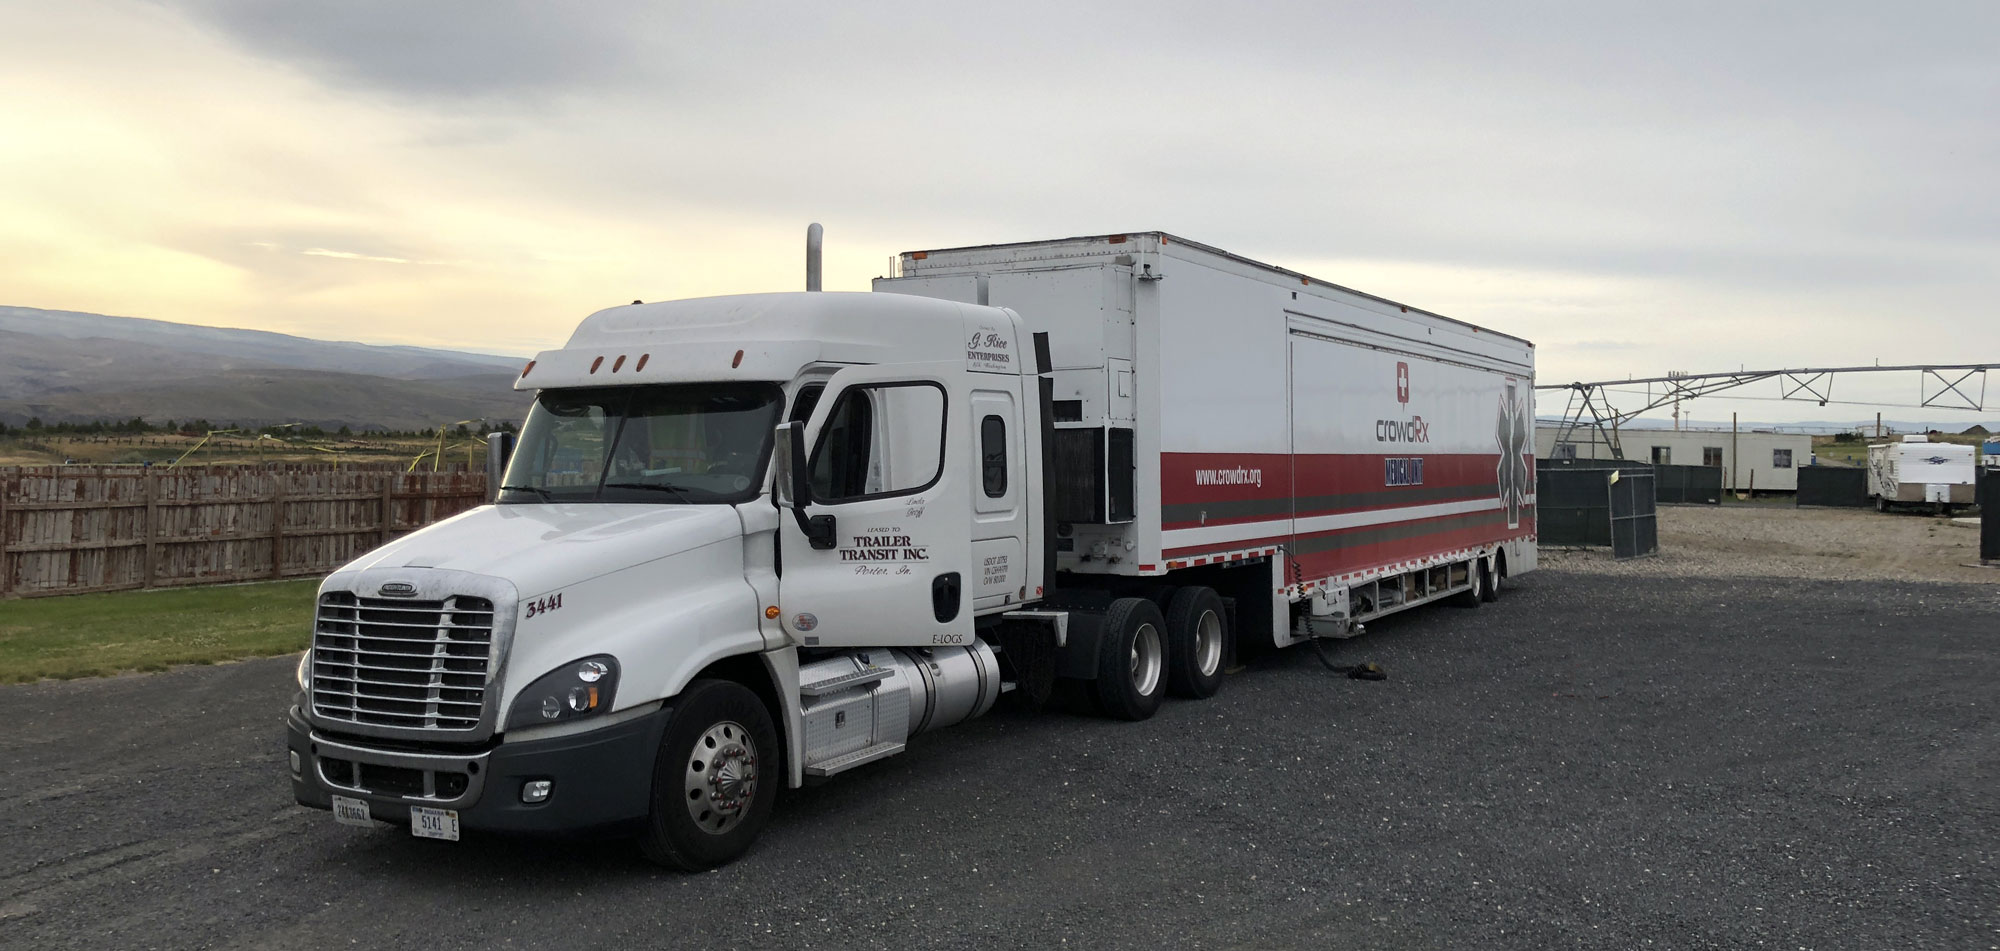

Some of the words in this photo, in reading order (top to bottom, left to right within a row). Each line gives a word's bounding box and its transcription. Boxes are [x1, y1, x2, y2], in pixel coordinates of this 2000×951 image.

[968, 332, 981, 349] G.
[984, 333, 1007, 349] Rice
[967, 351, 1009, 362] ENTERPRISES
[1376, 415, 1429, 443] crowdRx
[1195, 465, 1262, 488] www.crowdrx.org
[1385, 458, 1410, 486] MEDICAL
[853, 536, 911, 548] TRAILER
[840, 549, 898, 561] TRANSIT
[903, 549, 929, 560] INC.
[525, 593, 562, 619] 3441
[932, 634, 962, 643] E-LOGS
[421, 816, 442, 831] 5141
